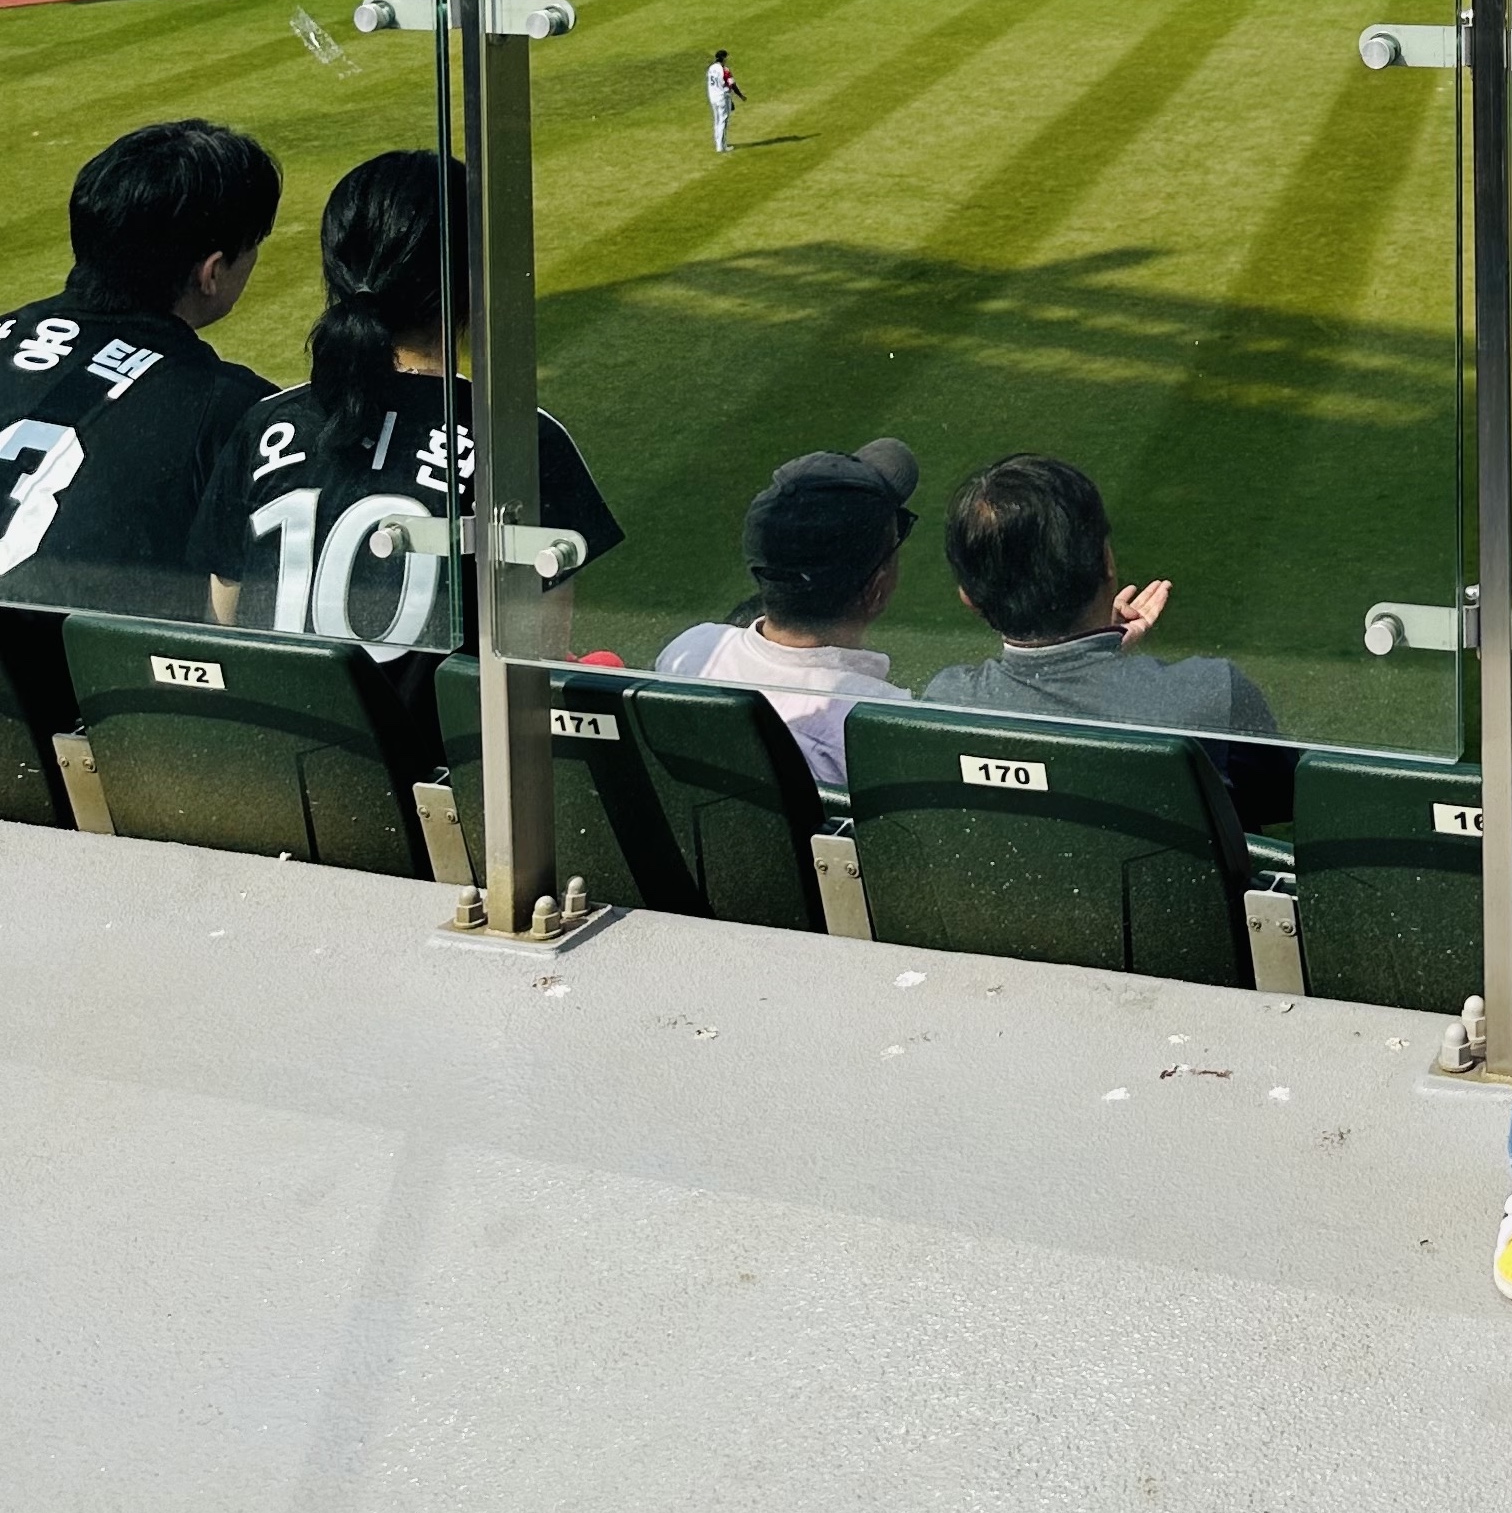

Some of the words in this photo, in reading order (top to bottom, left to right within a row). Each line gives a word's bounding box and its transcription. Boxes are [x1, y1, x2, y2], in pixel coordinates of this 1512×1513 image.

[0, 318, 164, 399] 용택
[249, 489, 441, 663] 10
[163, 661, 211, 685] 172
[553, 711, 602, 737] 171
[977, 762, 1031, 786] 170
